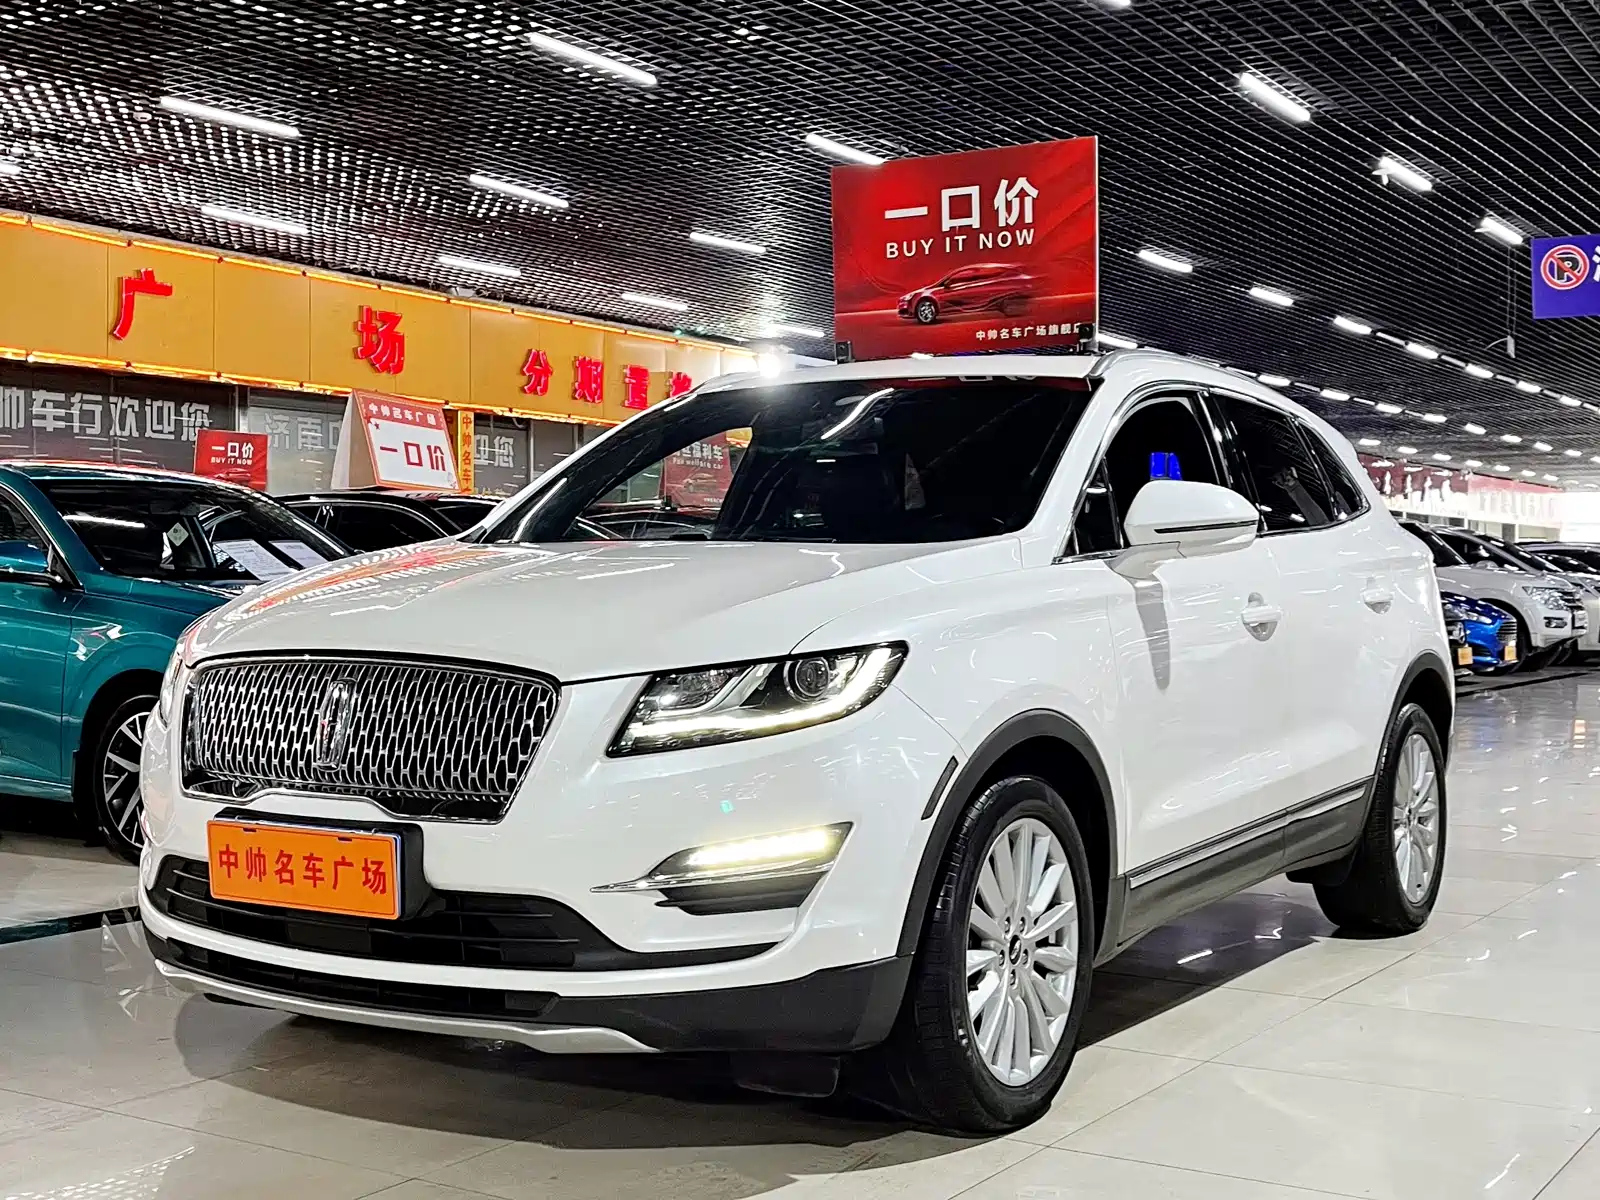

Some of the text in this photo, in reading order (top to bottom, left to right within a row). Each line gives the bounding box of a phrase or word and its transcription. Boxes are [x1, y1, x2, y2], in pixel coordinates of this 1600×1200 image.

[885, 177, 1039, 232] 一口价
[886, 228, 1035, 259] BUY IT NOW
[368, 402, 437, 425] 中帅名车广场
[211, 442, 254, 459] 一口价
[211, 456, 252, 466] BUY IT NOW
[380, 441, 446, 472] 一口价
[218, 844, 387, 895] 中帅名车广场
